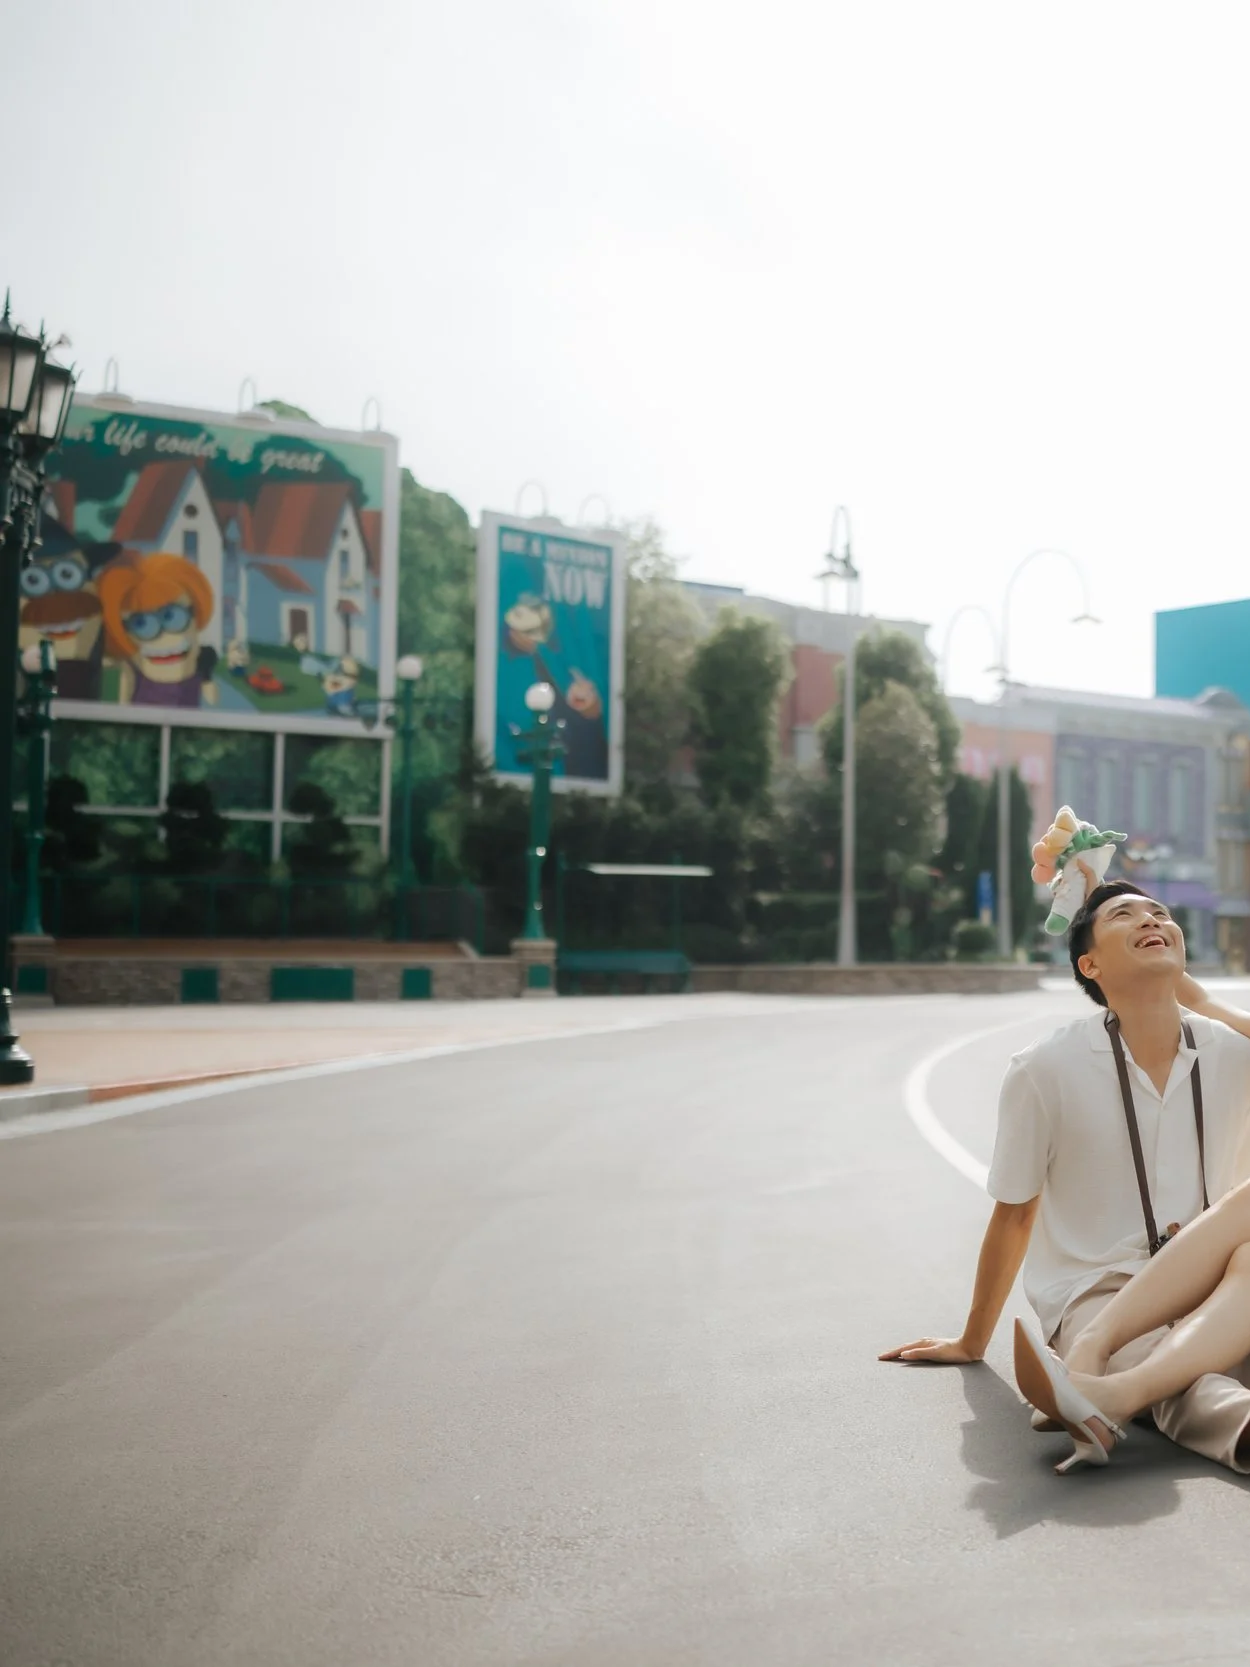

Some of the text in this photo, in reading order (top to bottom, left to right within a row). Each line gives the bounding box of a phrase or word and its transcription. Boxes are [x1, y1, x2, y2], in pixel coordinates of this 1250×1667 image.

[104, 419, 148, 456] life
[260, 449, 325, 474] great
[543, 561, 608, 610] NOW
